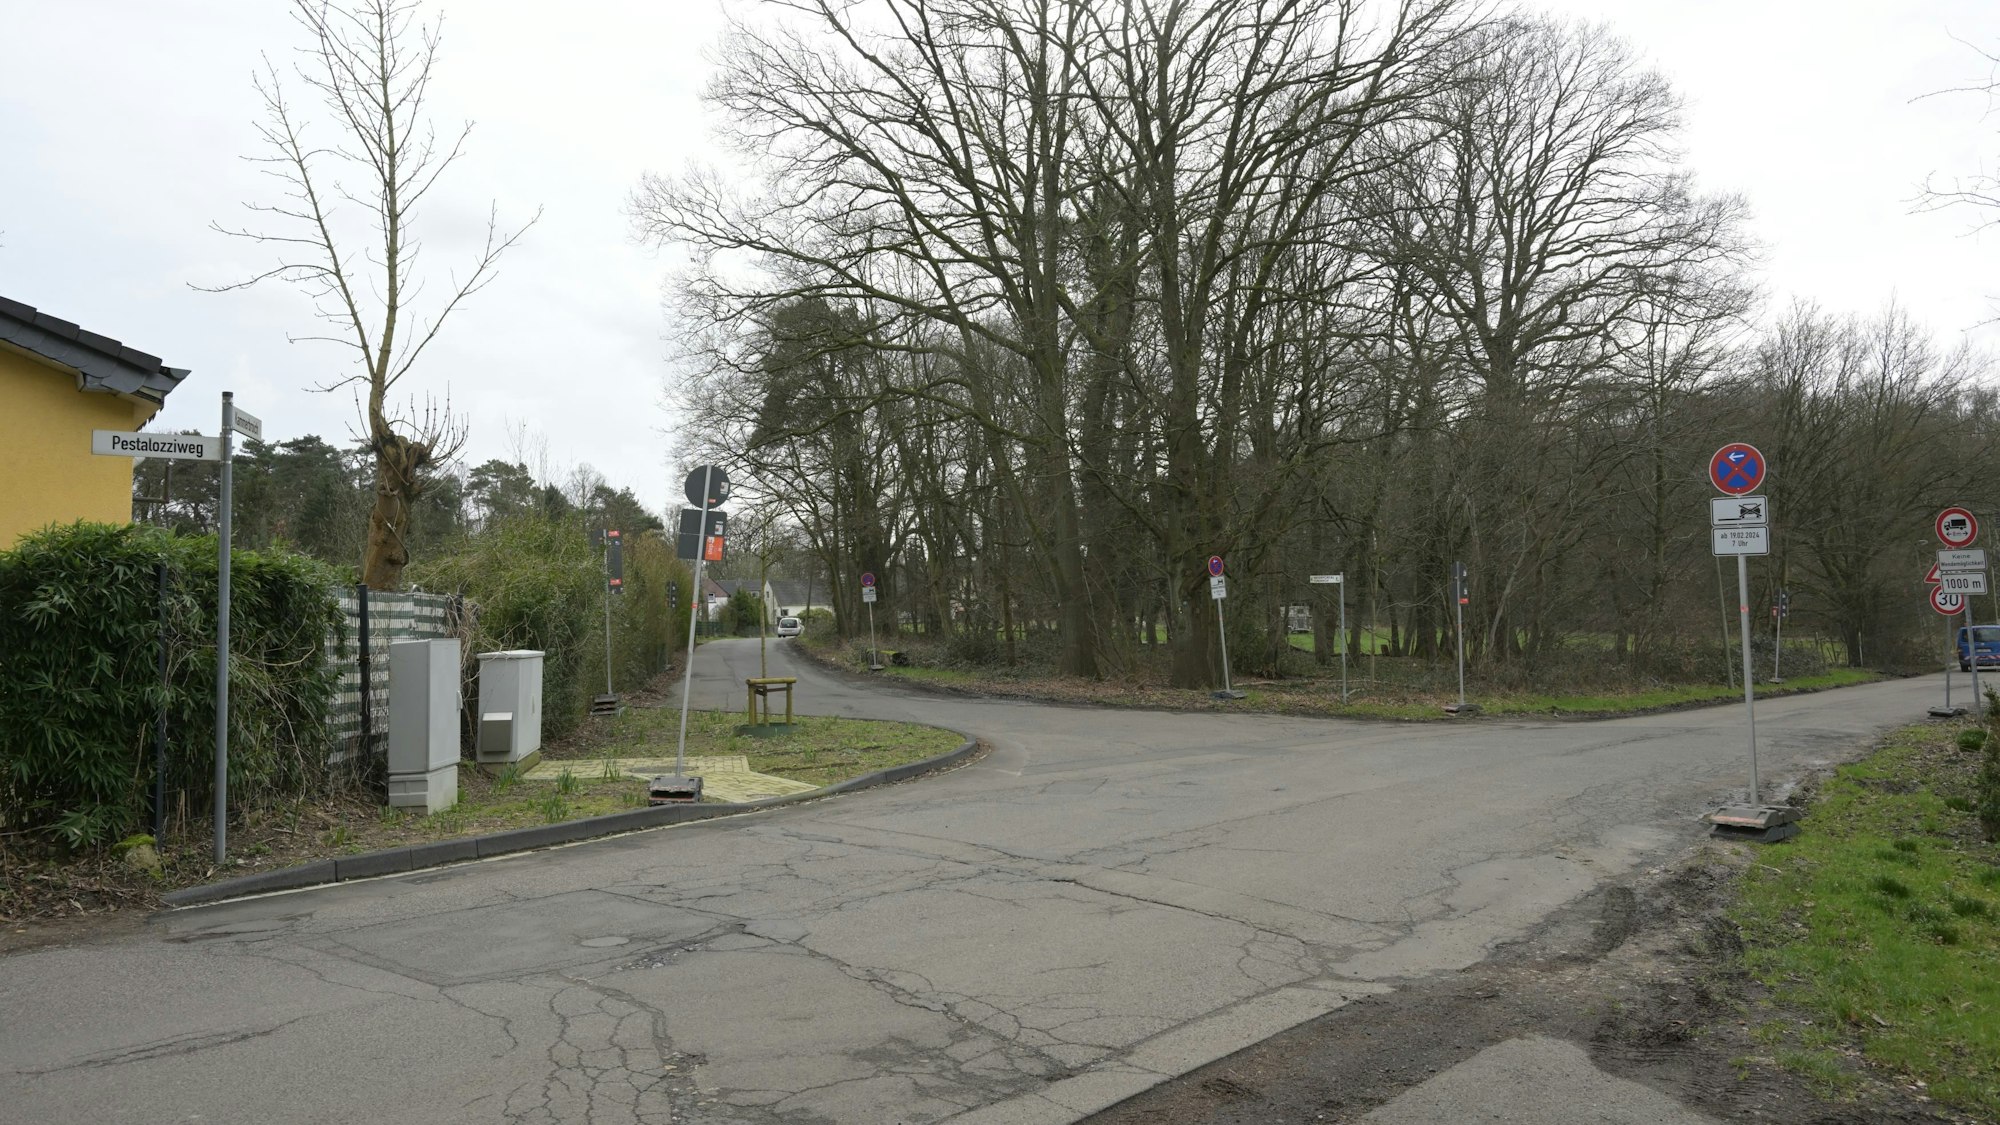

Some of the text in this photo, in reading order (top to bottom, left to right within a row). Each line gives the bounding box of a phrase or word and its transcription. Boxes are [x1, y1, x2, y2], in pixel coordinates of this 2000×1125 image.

[112, 435, 204, 458] Pestalozziweg
[1730, 531, 1760, 539] 19.02.2024
[1946, 578, 1982, 589] 1000 m
[1938, 592, 1959, 606] 30
